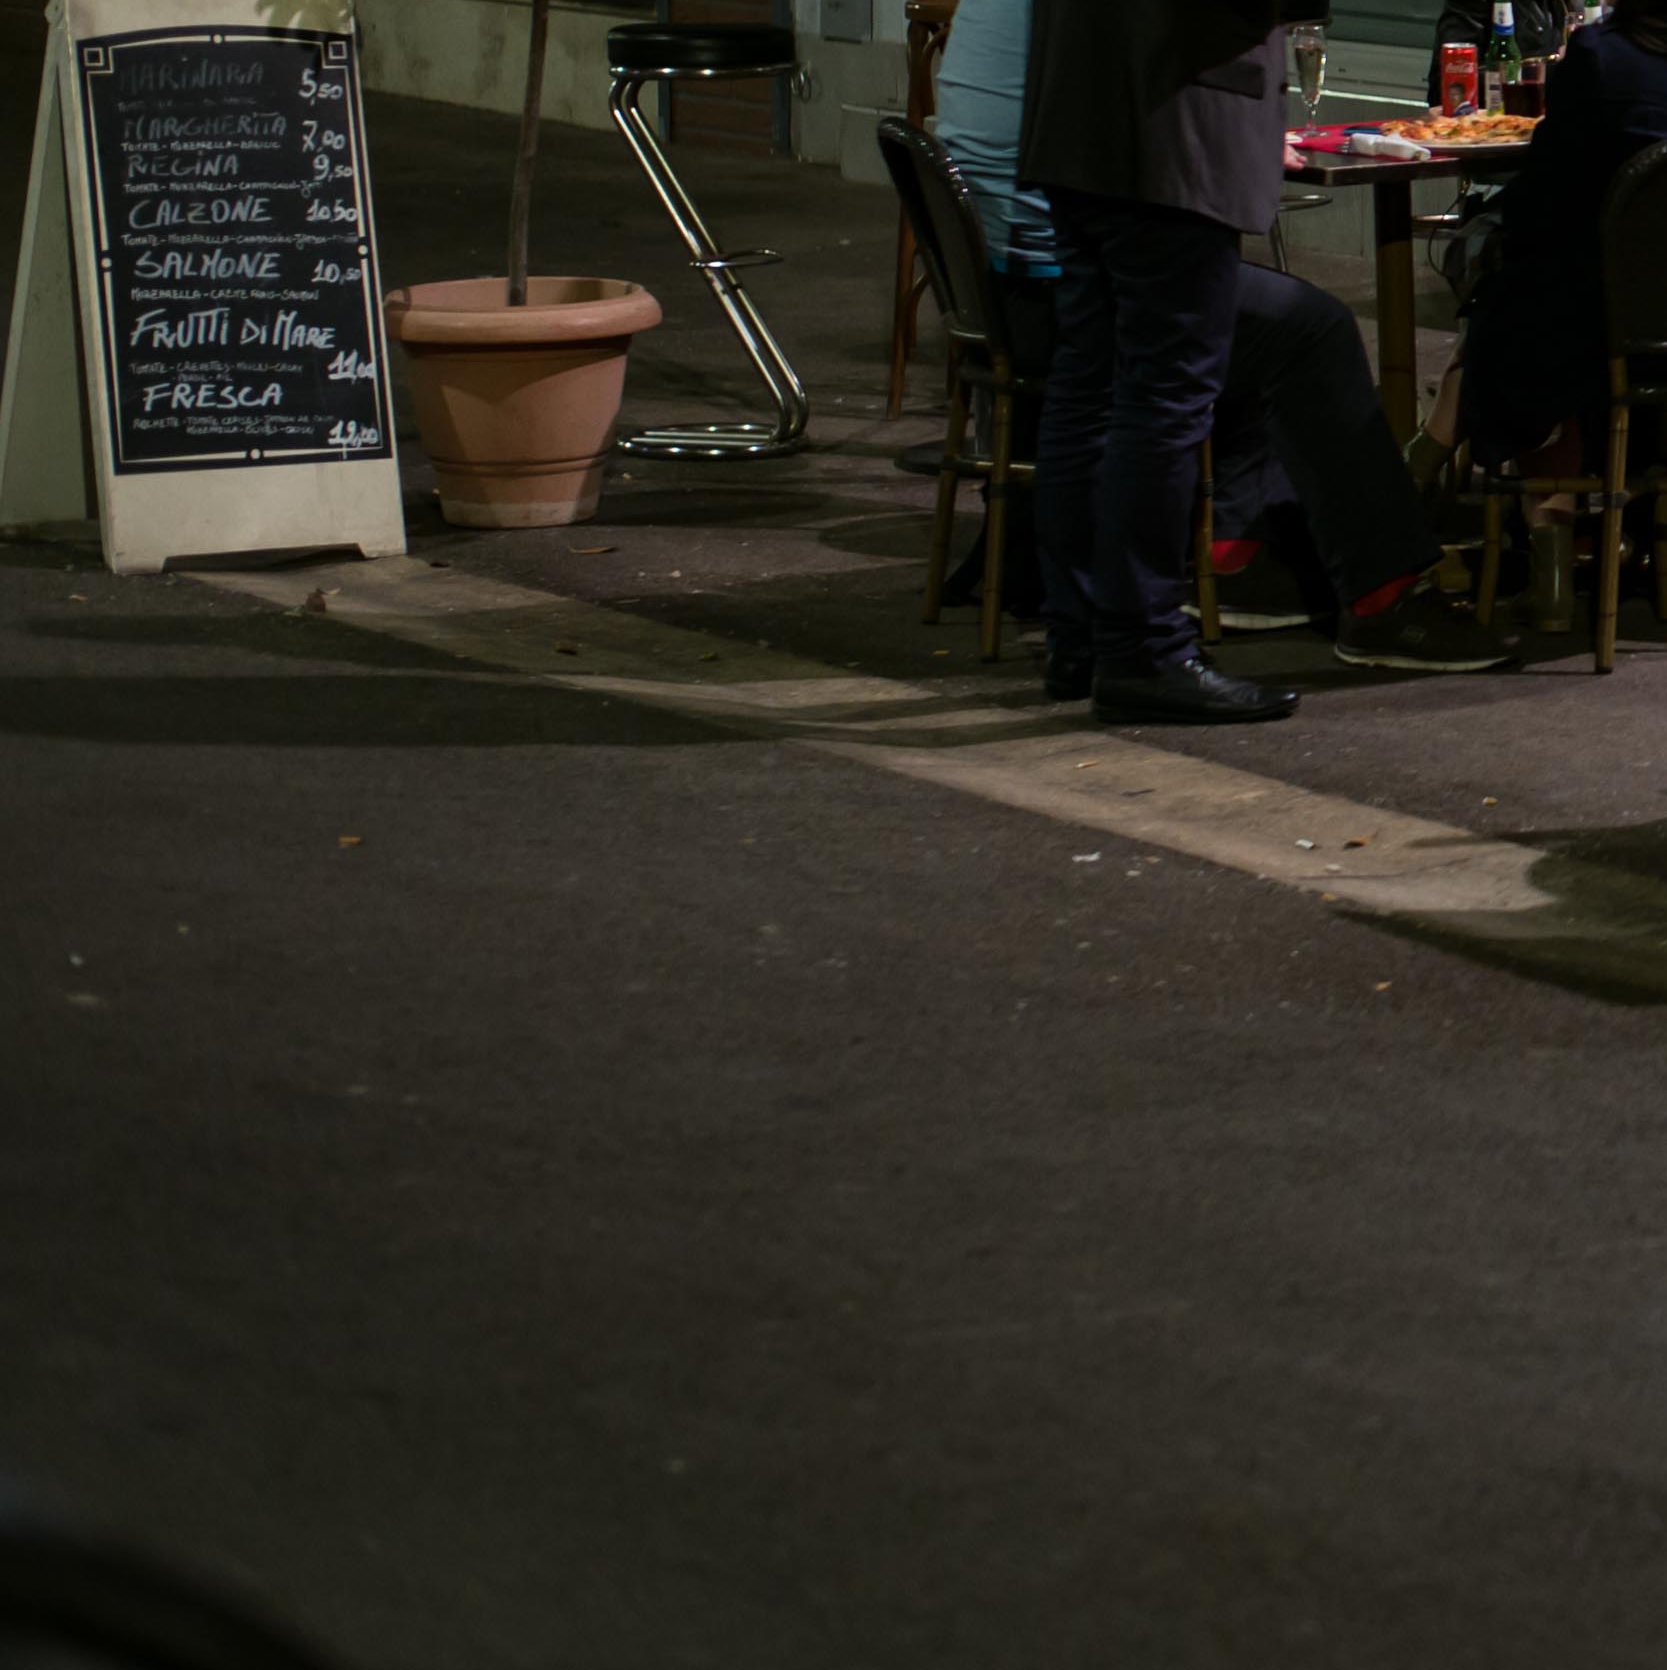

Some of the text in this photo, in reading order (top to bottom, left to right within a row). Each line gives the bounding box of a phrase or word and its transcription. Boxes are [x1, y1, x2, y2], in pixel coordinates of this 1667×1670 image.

[128, 194, 274, 230] CALZONE
[132, 247, 282, 280] SALMONE
[271, 308, 337, 351] MARE
[142, 382, 285, 412] FRESCA
